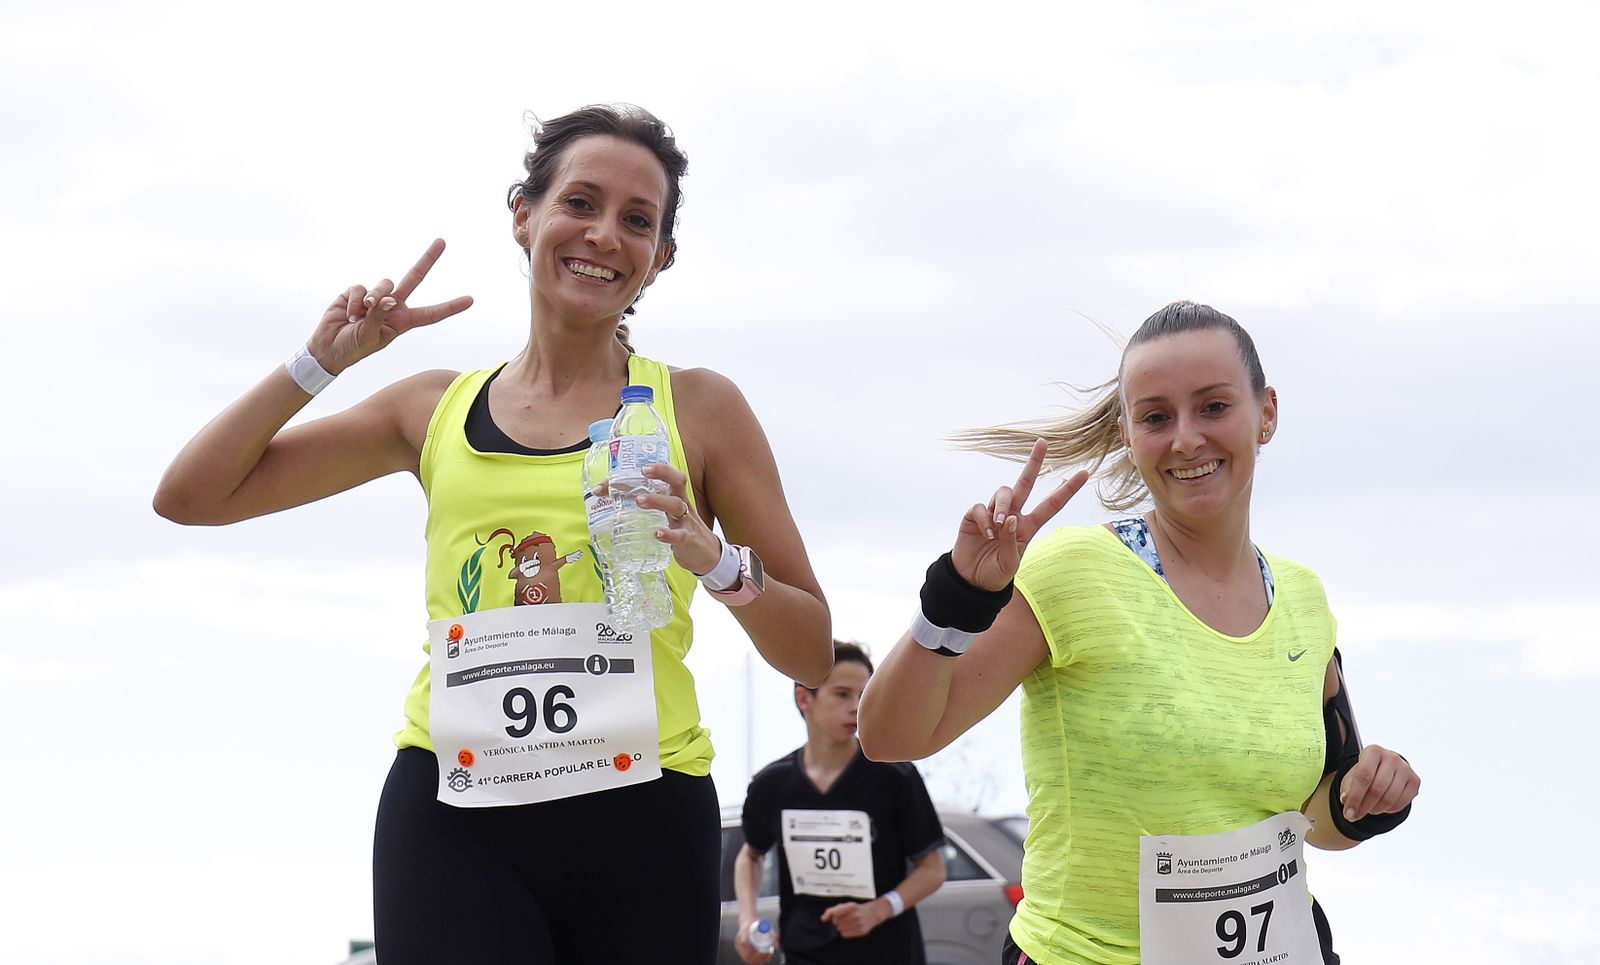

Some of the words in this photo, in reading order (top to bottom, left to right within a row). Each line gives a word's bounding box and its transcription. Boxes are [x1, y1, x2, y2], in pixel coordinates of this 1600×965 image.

[464, 630, 525, 646] Ayuntamiento
[542, 626, 576, 637] Málaga
[464, 646, 477, 654] Área
[485, 642, 508, 650] Deporte
[462, 661, 555, 681] www.deporte.malaga.eu
[502, 685, 578, 739] 96
[483, 745, 526, 757] VERÓNICA
[528, 741, 566, 752] BASTIDA
[567, 737, 605, 747] MARTOS
[493, 772, 542, 785] CARRERA
[545, 761, 594, 778] POPULAR
[597, 759, 611, 768] EL
[814, 848, 841, 870] 50
[1177, 855, 1238, 868] Ayuntamiento
[1240, 852, 1249, 860] de
[1250, 844, 1272, 857] Málaga
[1172, 882, 1260, 900] www.deporte.malaga.eu
[1215, 900, 1274, 959] 97
[1262, 952, 1289, 965] MARTOS
